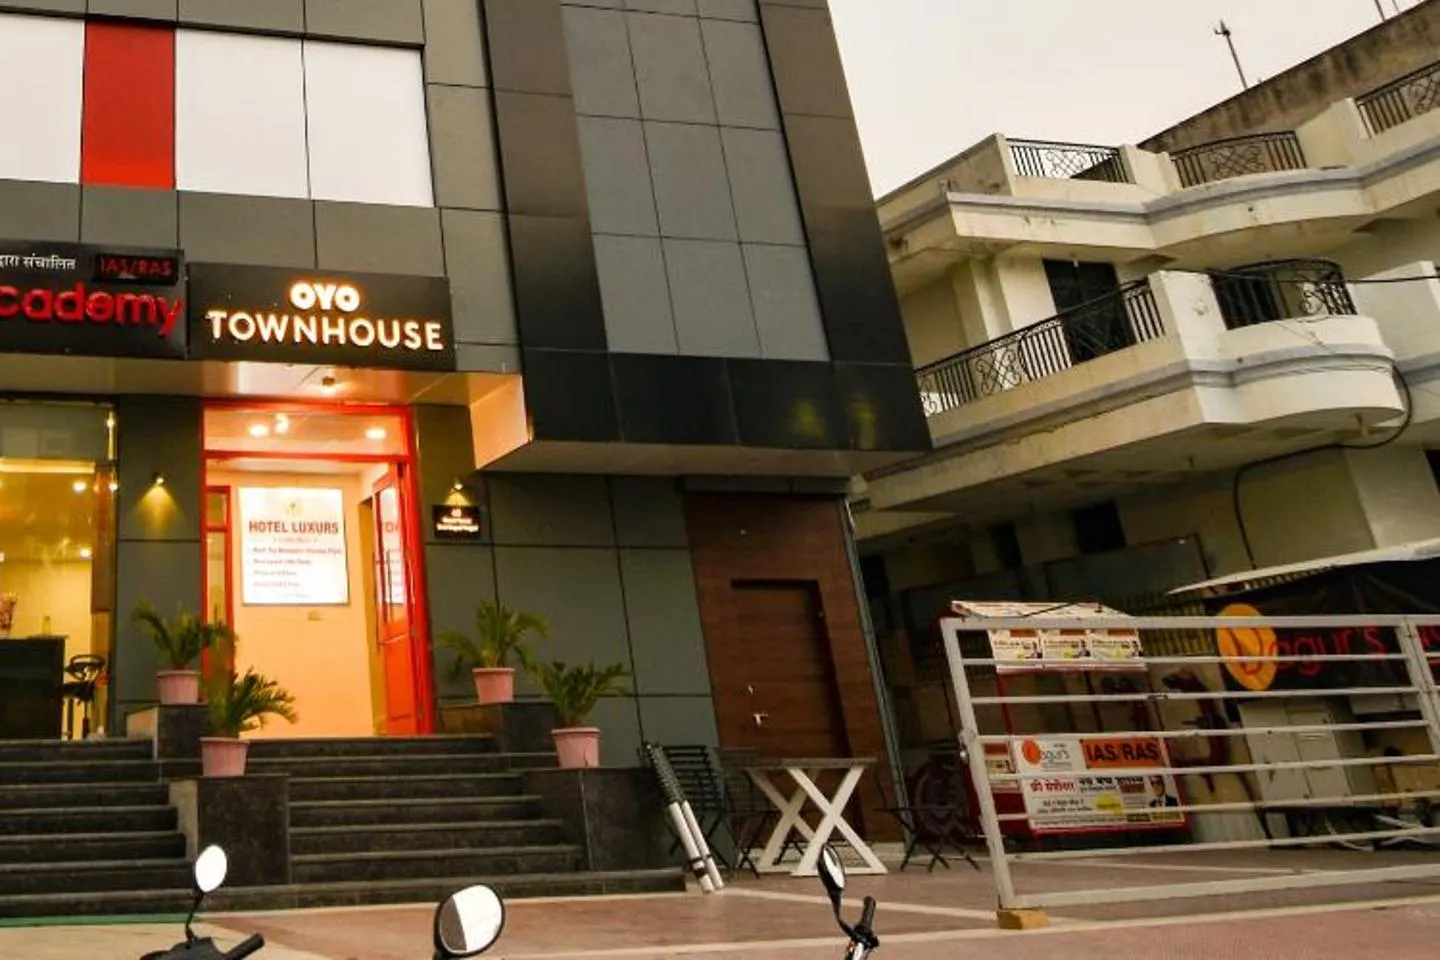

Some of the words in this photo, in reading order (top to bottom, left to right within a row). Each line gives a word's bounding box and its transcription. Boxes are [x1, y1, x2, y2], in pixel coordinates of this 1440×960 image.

[22, 252, 76, 271] संचालित
[289, 280, 360, 312] OYO
[206, 310, 444, 350] TOWNHOUSE
[249, 520, 288, 533] HOTEL
[1122, 742, 1159, 761] RAS
